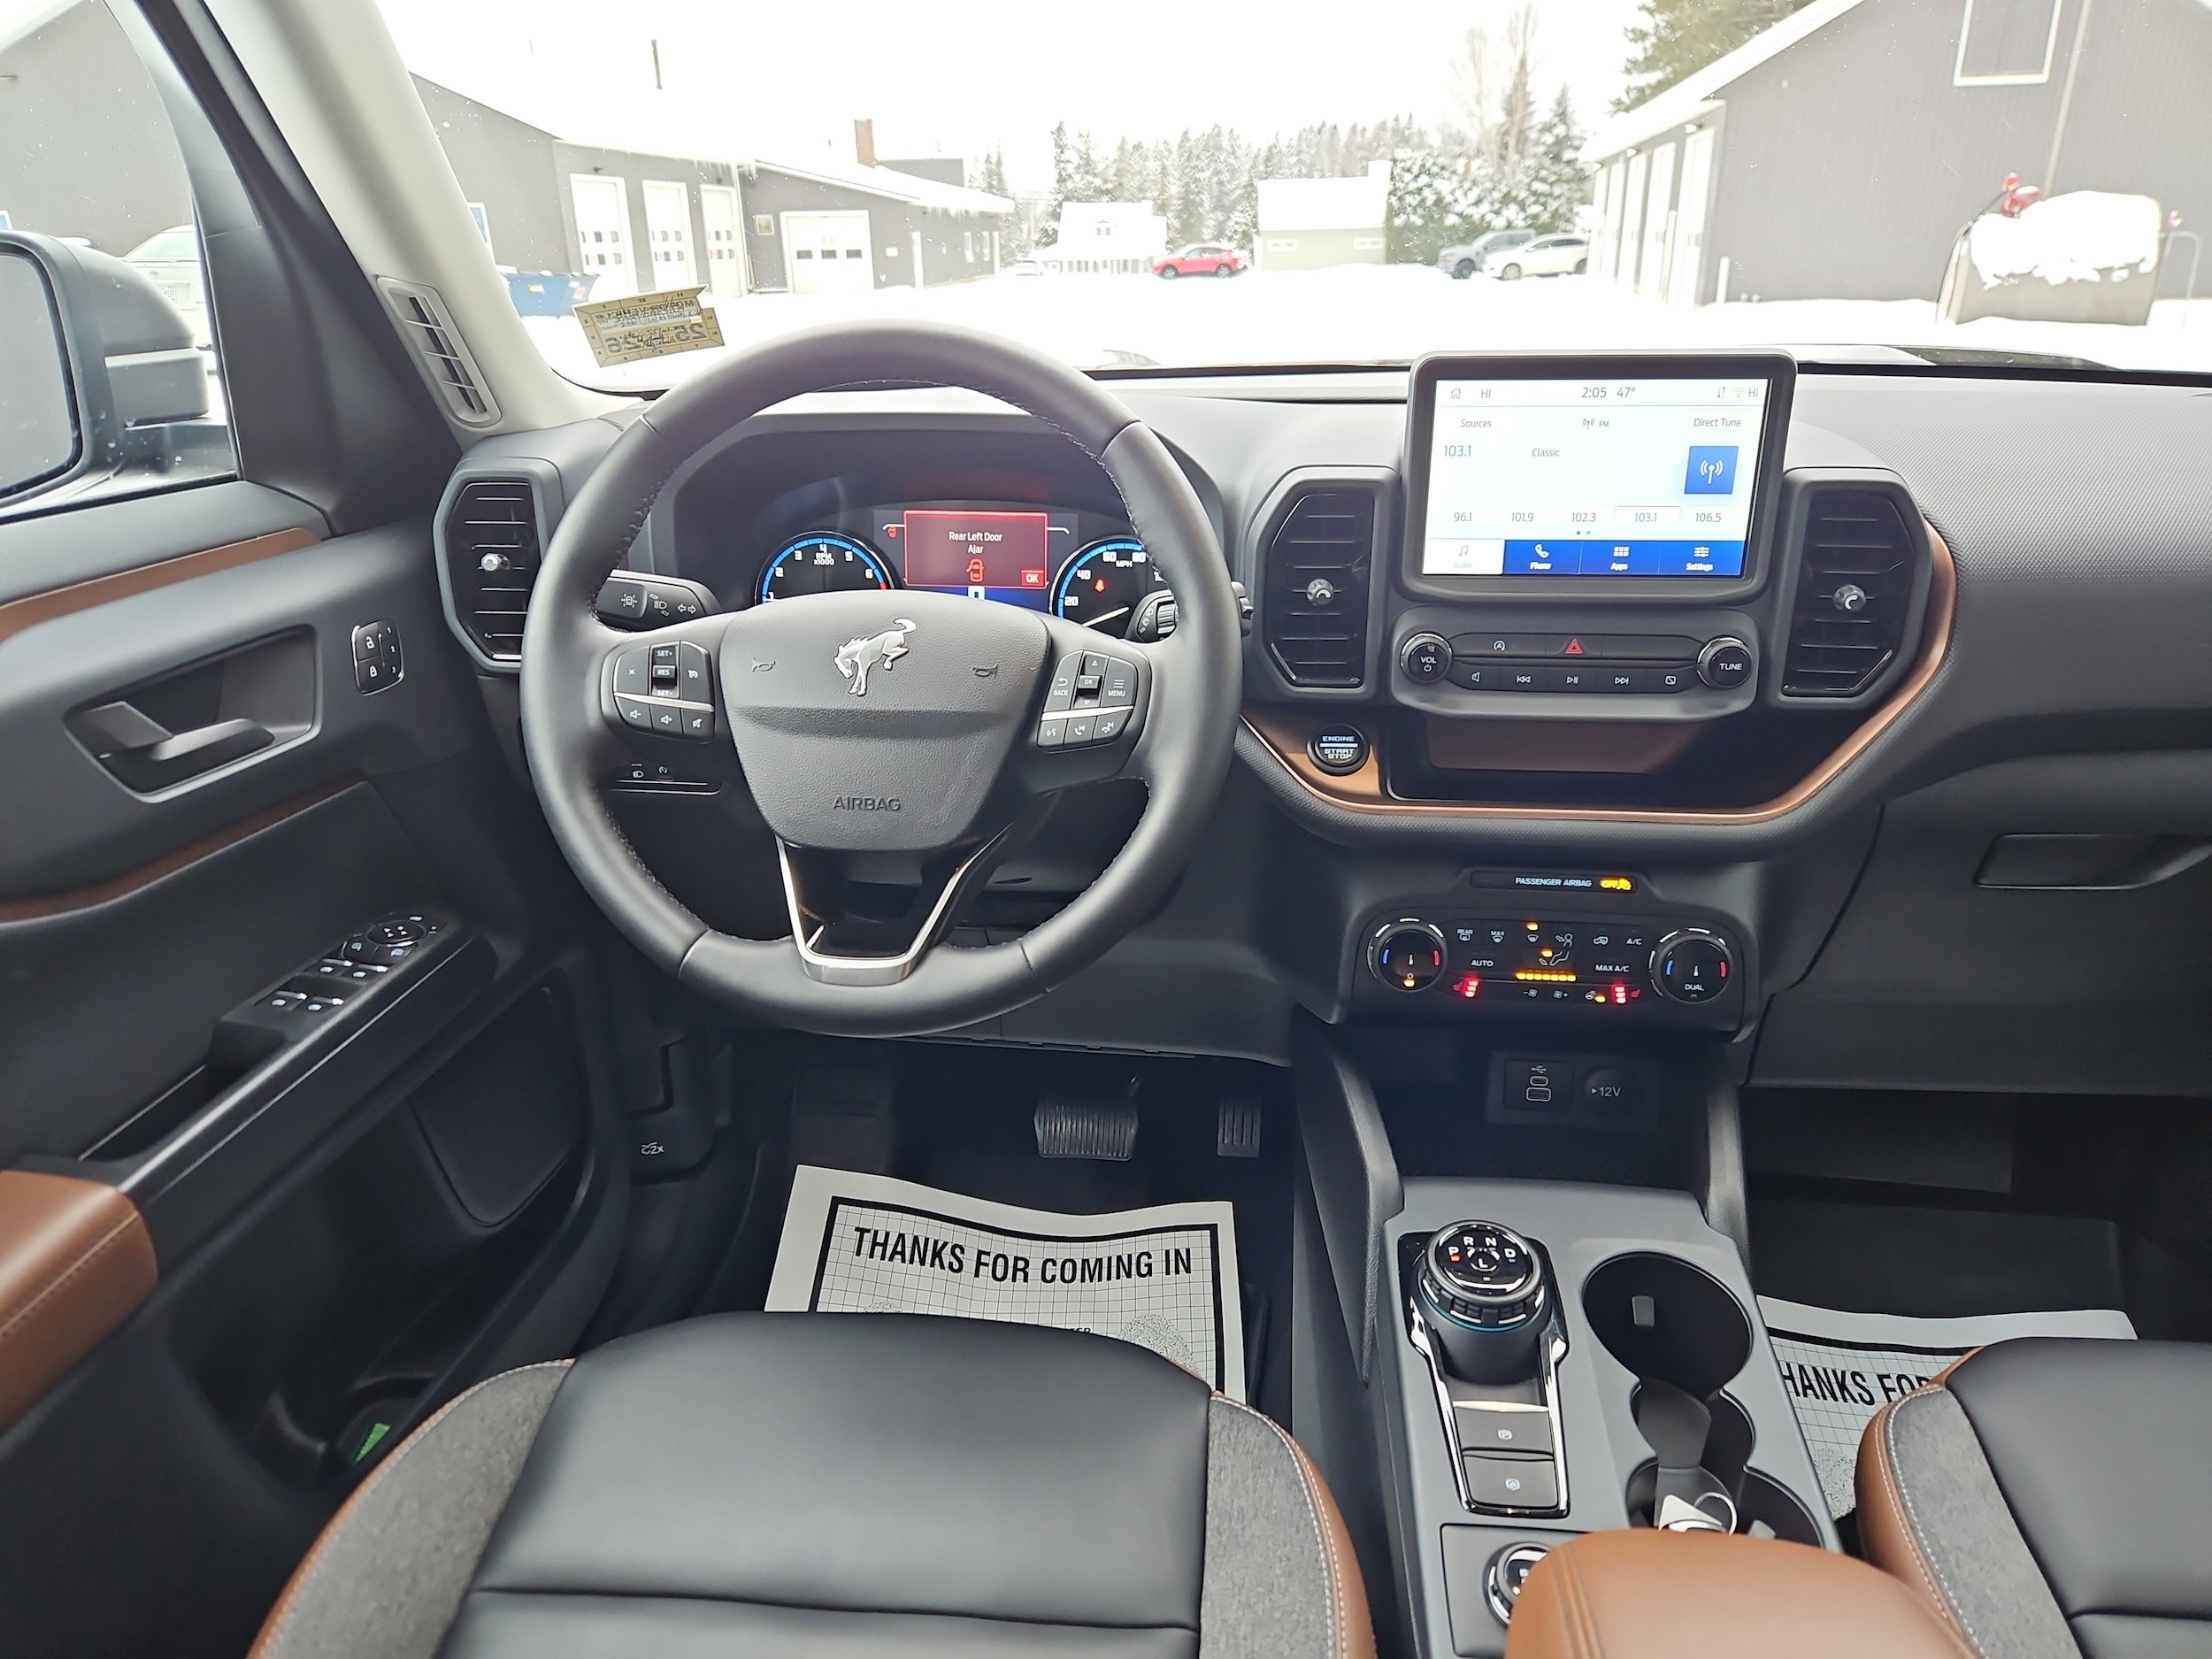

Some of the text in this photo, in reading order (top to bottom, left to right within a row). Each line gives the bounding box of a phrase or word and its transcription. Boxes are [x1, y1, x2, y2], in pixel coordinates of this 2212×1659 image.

[1480, 387, 1759, 399] HI 2:05 47° HI
[1460, 418, 1493, 429] Sources
[1694, 418, 1741, 427] Direct Tune
[1443, 445, 1471, 457] 103.1
[1532, 447, 1560, 457] Classic
[1453, 511, 1472, 523] 96.1
[1510, 511, 1534, 523] 101.9
[1571, 511, 1596, 523] 102.3
[1634, 512, 1657, 523] 103.1
[1695, 511, 1722, 523] 106.5
[949, 532, 1002, 542] Rear Left Door
[819, 543, 827, 554] 4
[967, 544, 984, 554] Ajar
[794, 550, 803, 561] 3
[844, 551, 853, 562] 5
[1102, 551, 1117, 562] 60
[1132, 552, 1147, 563] 80
[775, 567, 784, 577] 2
[1530, 562, 1551, 571] Phone
[1610, 563, 1629, 572] Apps
[1686, 562, 1714, 572] Settings
[864, 569, 873, 579] 6
[1025, 573, 1039, 584] OK
[1076, 570, 1091, 580] 40
[1064, 596, 1079, 606] 20
[1420, 656, 1437, 664] VOL
[1719, 663, 1743, 672] TUNE
[833, 797, 901, 812] AIRBAG
[1515, 877, 1562, 886] PASSENGER
[1563, 879, 1592, 887] AIRBAG
[1599, 1087, 1622, 1097] 12V
[1448, 1236, 1517, 1258] P R N D
[854, 1226, 1192, 1285] THANKS FOR COMING IN
[1479, 1257, 1488, 1269] L
[1778, 1361, 1875, 1406] HANKS
